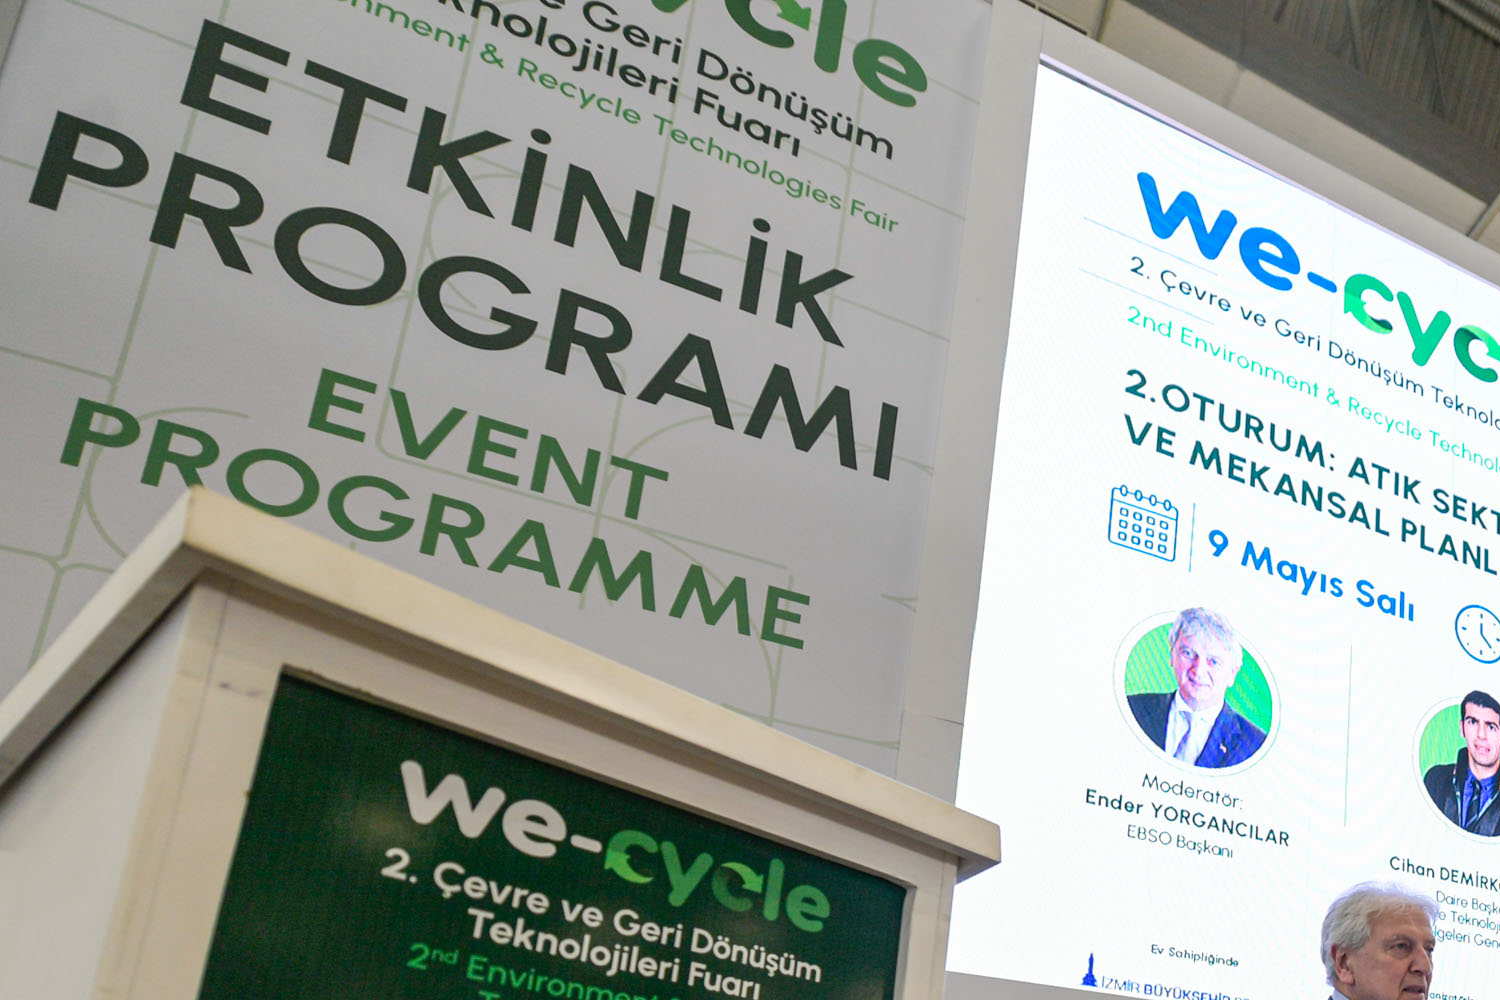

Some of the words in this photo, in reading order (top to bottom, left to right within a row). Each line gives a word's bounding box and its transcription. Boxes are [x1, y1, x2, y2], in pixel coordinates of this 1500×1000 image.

[581, 0, 682, 65] Geri
[696, 48, 894, 160] Dönüşüm
[651, 0, 928, 108] cle
[180, 19, 855, 348] ETKİNLİK
[479, 42, 504, 69] &
[516, 57, 642, 126] Recycle
[653, 113, 842, 210] Technologies
[849, 198, 900, 234] Fair
[692, 87, 801, 157] Fuarı
[28, 111, 899, 481] PROGRAMI
[1129, 256, 1152, 282] 2.
[1159, 269, 1232, 313] Çevre
[1239, 303, 1267, 328] ve
[1274, 318, 1322, 353] Geri
[1328, 341, 1425, 398] Dönüşüm
[1123, 367, 1336, 473] 2.OTURUM:
[1347, 455, 1423, 506] ATIK
[1127, 305, 1173, 340] 2nd
[1180, 326, 1320, 400] Environment
[1325, 385, 1341, 407] &
[1347, 395, 1423, 442] Recycle
[307, 367, 669, 520] EVENT
[1123, 413, 1177, 459] VE
[1189, 436, 1391, 538] MEKANSAL
[59, 397, 811, 650] PROGRAMME
[1207, 528, 1230, 558] 9
[1240, 539, 1345, 598] Mayıs
[1355, 578, 1416, 623] Salı
[399, 759, 832, 933] we-cycle
[1085, 788, 1144, 815] Ender
[1151, 801, 1290, 848] YORGANCILAR
[1126, 823, 1172, 846] EBSO
[1176, 833, 1234, 859] Başkanı
[1141, 773, 1244, 811] Moderatör:
[380, 846, 419, 885] 2.
[432, 860, 550, 917] Çevre
[560, 899, 605, 929] ve
[612, 907, 684, 950] Geri
[690, 927, 823, 984] Dönüşüm
[1389, 856, 1435, 879] Cihan
[406, 943, 459, 972] 2nd
[466, 907, 681, 984] Teknolojileri
[1150, 944, 1164, 955] Ev
